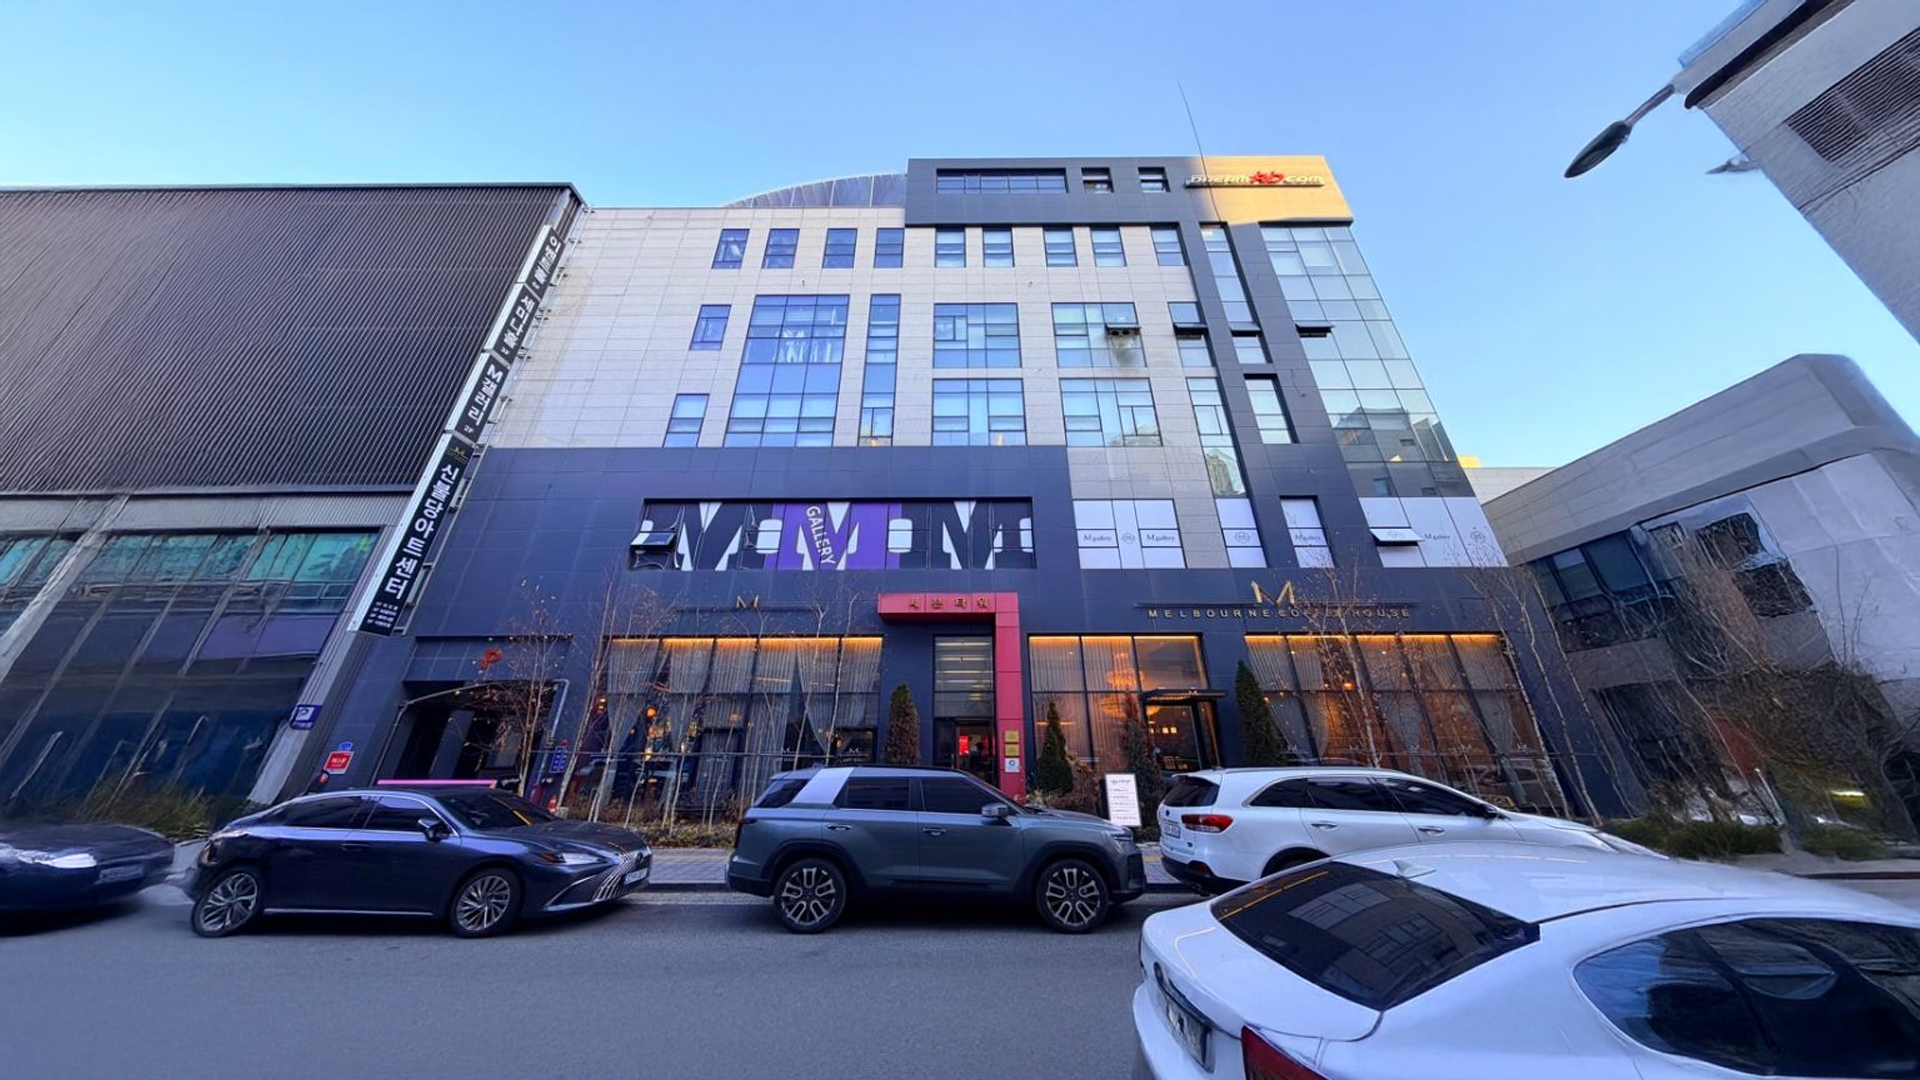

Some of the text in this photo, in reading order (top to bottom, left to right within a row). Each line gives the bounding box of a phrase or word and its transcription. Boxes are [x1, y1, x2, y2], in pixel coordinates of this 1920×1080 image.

[504, 296, 535, 349] 세미나홀
[468, 365, 504, 426] M갤러리
[806, 506, 836, 565] GALLERY
[1148, 608, 1271, 618] MELBOURNE
[1251, 580, 1296, 606] M
